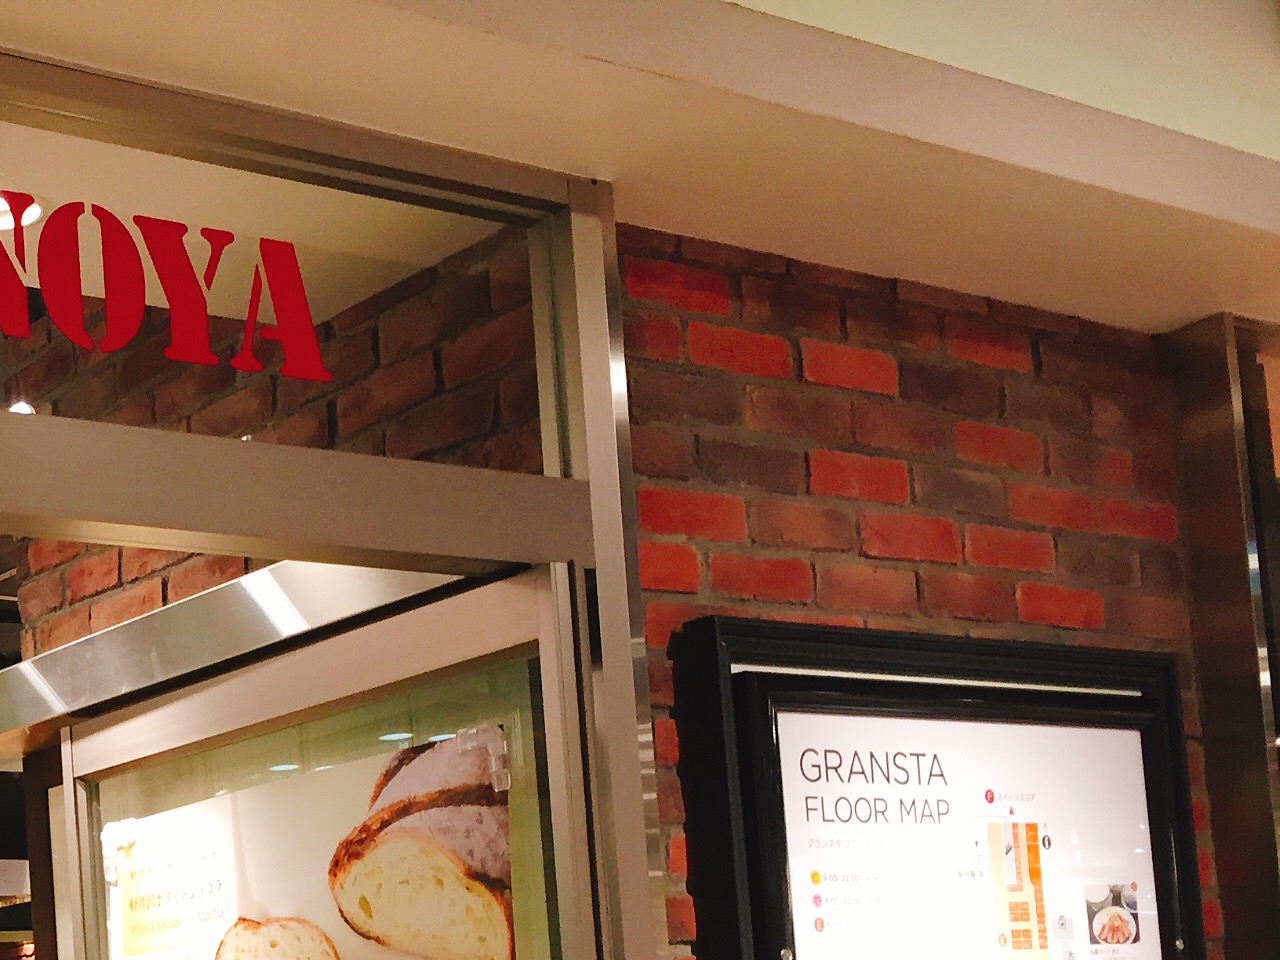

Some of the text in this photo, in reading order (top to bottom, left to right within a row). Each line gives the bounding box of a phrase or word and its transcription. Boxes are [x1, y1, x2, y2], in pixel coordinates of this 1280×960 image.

[799, 747, 948, 786] GRANSTA
[805, 796, 949, 824] FLOOR MAP
